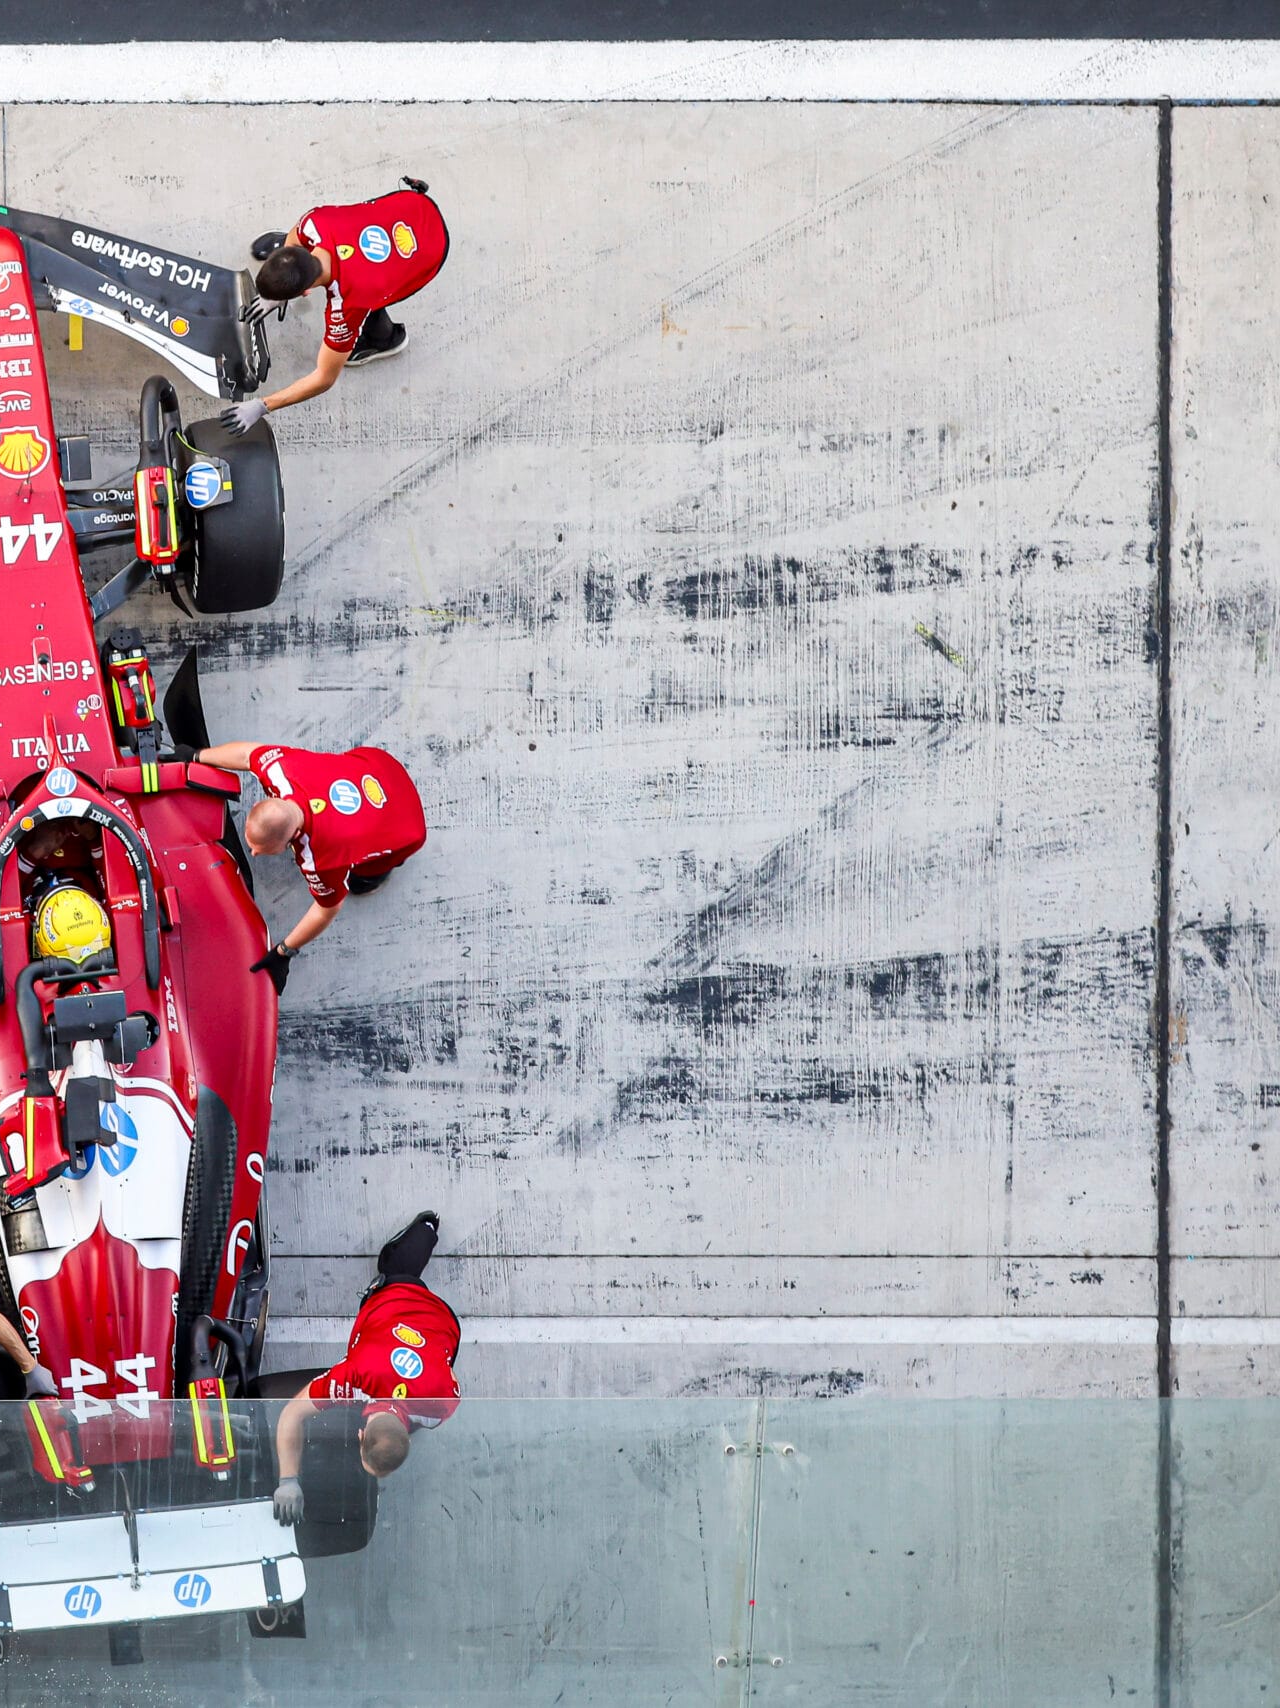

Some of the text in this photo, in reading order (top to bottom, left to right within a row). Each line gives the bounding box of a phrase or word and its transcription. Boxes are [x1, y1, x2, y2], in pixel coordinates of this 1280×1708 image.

[71, 229, 212, 292] HCLSoftware
[360, 226, 390, 262] hp
[98, 281, 170, 325] V-Power
[185, 461, 221, 508] hp
[93, 512, 136, 526] vantage
[11, 733, 91, 758] ITALIA
[47, 768, 77, 797] hp
[330, 780, 360, 814] hp
[57, 800, 72, 814] hp
[89, 809, 112, 826] IBM
[0, 836, 12, 854] aws
[164, 976, 179, 1034] IBM
[392, 1349, 422, 1377] hp
[61, 1358, 113, 1424] 44
[114, 1353, 160, 1419] 44
[64, 1584, 102, 1619] hp
[174, 1573, 211, 1608] hp
